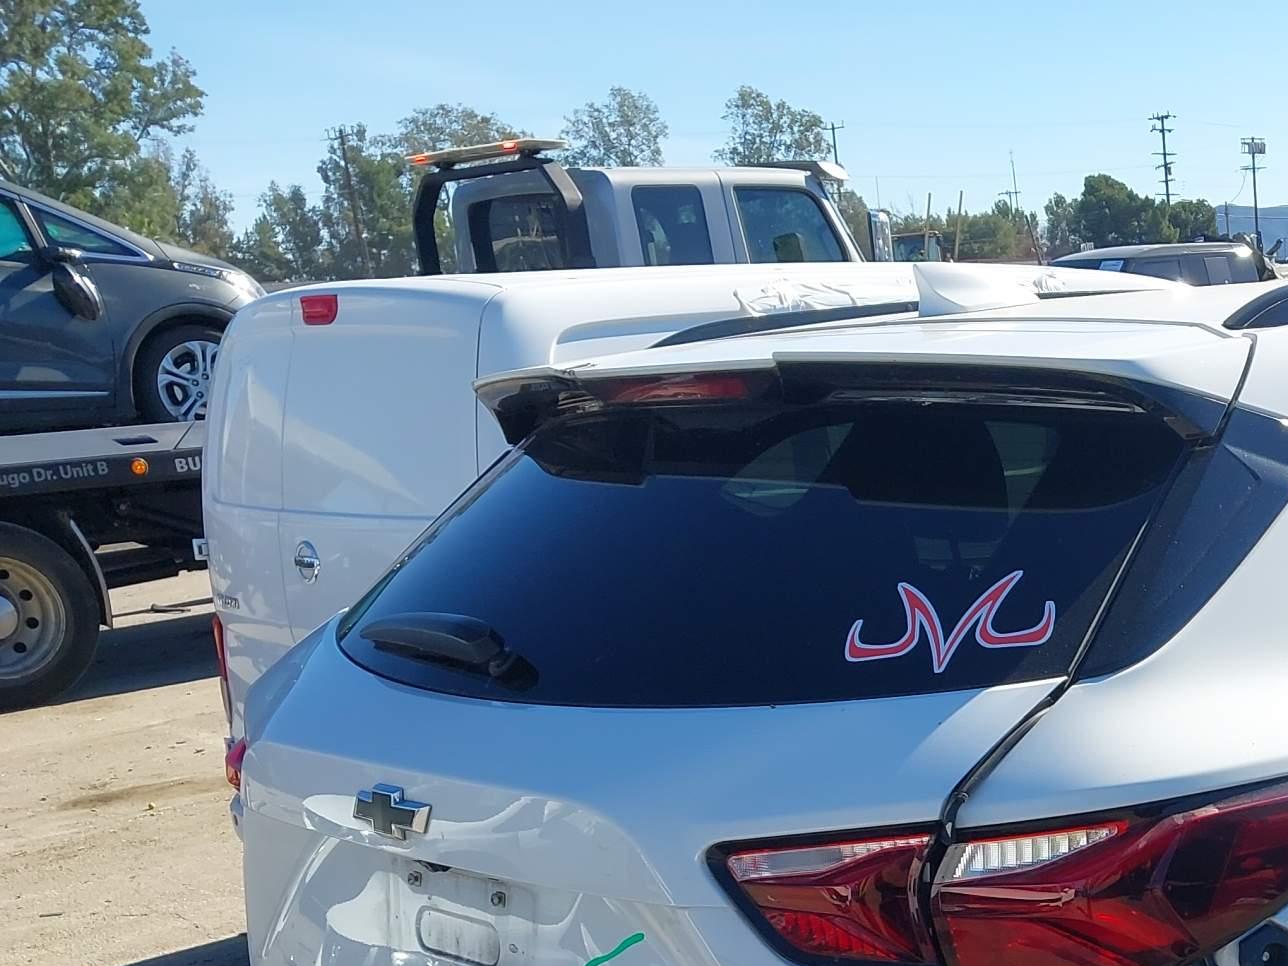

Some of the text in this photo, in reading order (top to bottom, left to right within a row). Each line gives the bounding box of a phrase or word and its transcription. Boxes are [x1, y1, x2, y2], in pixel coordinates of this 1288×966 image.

[33, 467, 57, 483] Dr.
[59, 463, 95, 480] Unit
[97, 462, 109, 476] B
